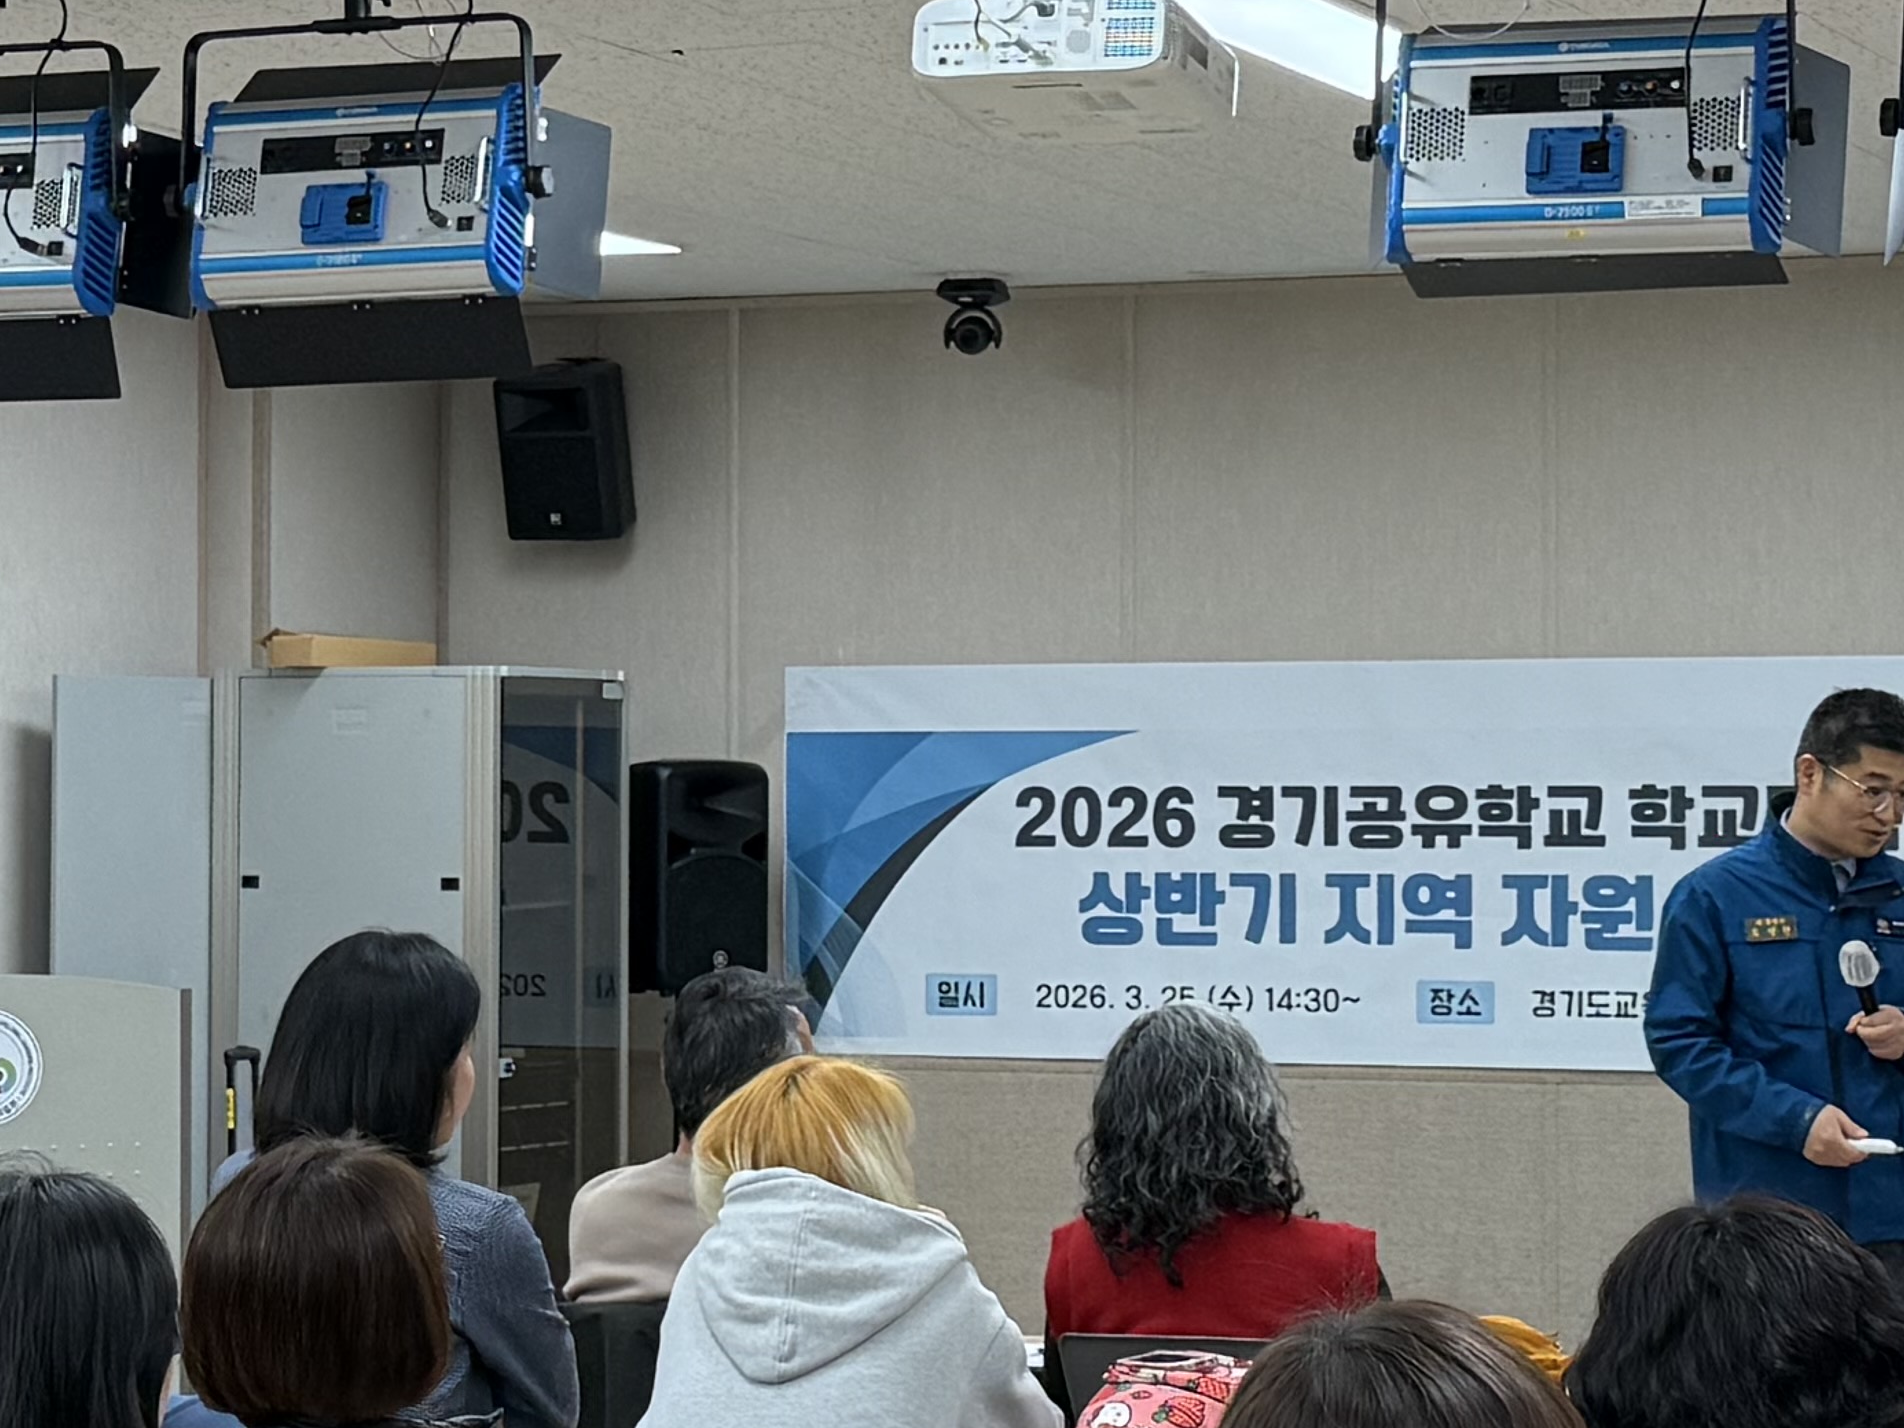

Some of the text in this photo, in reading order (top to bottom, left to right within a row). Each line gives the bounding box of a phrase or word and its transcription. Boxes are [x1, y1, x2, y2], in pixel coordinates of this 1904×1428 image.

[1014, 785, 1196, 849] 2026
[1217, 784, 1607, 851] 경기공유학교
[1078, 871, 1297, 947] 상반기
[1324, 872, 1474, 950] 지역
[1500, 873, 1655, 952] 자원
[937, 981, 985, 1009] 일시
[1035, 983, 1114, 1010] 2026.
[1124, 985, 1150, 1011] 3.
[1264, 987, 1361, 1013] 14:30~
[1429, 987, 1483, 1018] 장소
